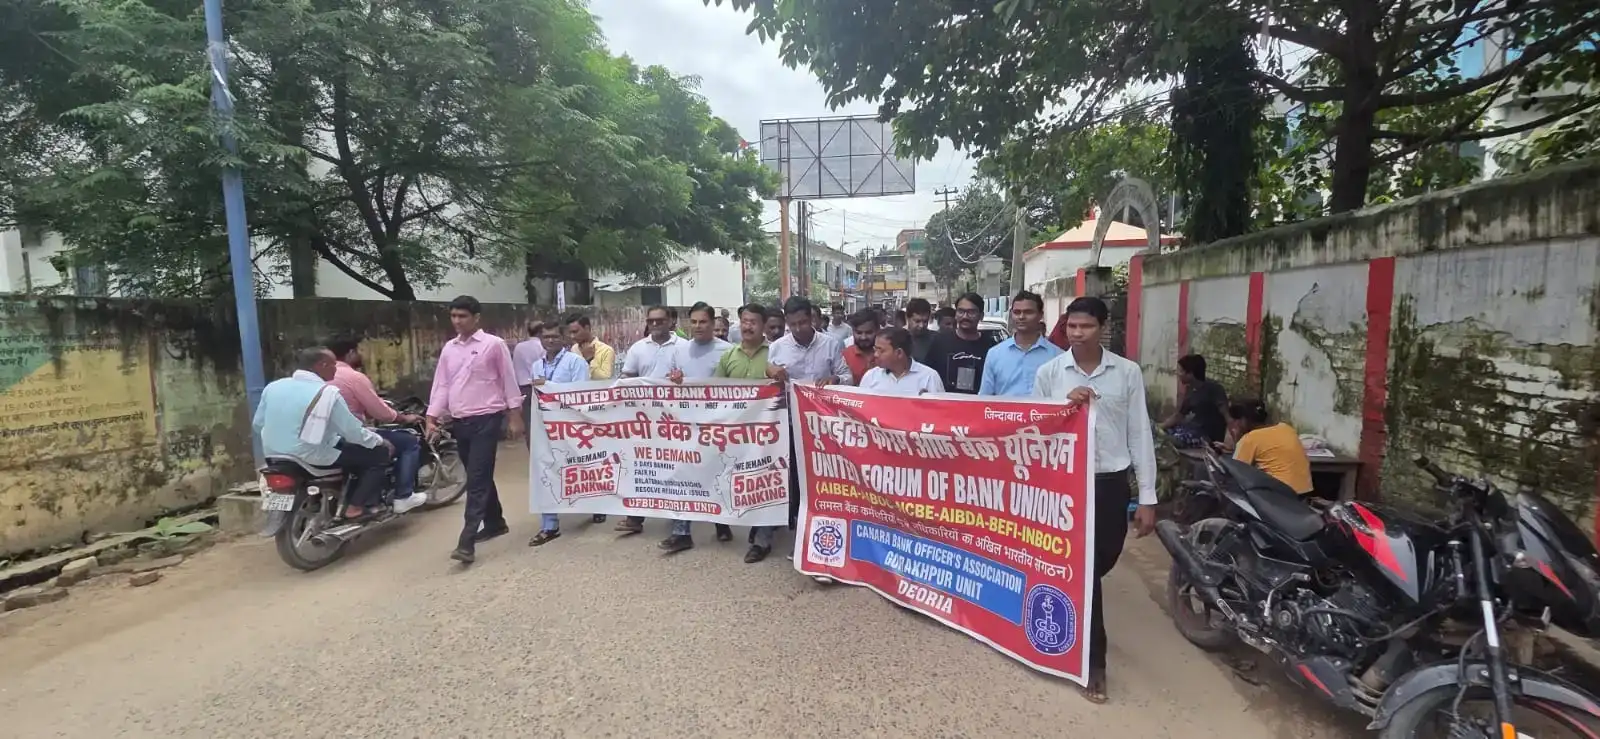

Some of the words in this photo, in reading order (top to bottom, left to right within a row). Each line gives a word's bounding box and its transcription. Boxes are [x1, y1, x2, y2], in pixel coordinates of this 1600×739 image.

[613, 387, 653, 400] FORUM
[656, 386, 671, 399] OF
[673, 386, 706, 399] BANK
[709, 386, 759, 399] UNIONS
[543, 411, 652, 449] राष्ट्रव्यापी
[656, 411, 692, 441] बैंक
[696, 421, 780, 452] हड़ताल
[577, 450, 607, 463] DEMAND
[634, 447, 652, 459] WE
[655, 447, 702, 464] DEMAND
[998, 425, 1077, 481] यूनियन
[734, 462, 745, 470] WE
[745, 456, 771, 470] DEMAND
[565, 467, 578, 484] 5
[580, 465, 614, 482] DAYS
[634, 469, 647, 477] FAIR
[565, 480, 615, 496] BANKING
[635, 486, 660, 494] RESOLVE
[734, 475, 745, 494] 5
[746, 472, 783, 493] DAYS
[628, 498, 690, 512] UFBU-DEORIA
[693, 501, 717, 513] UNIT
[734, 486, 787, 506] BANKING
[861, 464, 922, 498] FORUM
[928, 470, 949, 501] OF
[953, 473, 1005, 512] BANK
[1010, 482, 1074, 532] UNIONS
[856, 524, 891, 545] CANARA
[892, 534, 912, 554] BANK
[914, 541, 961, 568] OFFICER'S
[962, 556, 1022, 594] ASSOCIATION
[962, 532, 974, 545] का
[976, 535, 1002, 555] अखिल
[1005, 545, 1033, 568] भारतीय
[884, 551, 952, 588] GORAKHPUR
[955, 574, 983, 601] UNIT
[897, 579, 952, 614] DEORIA
